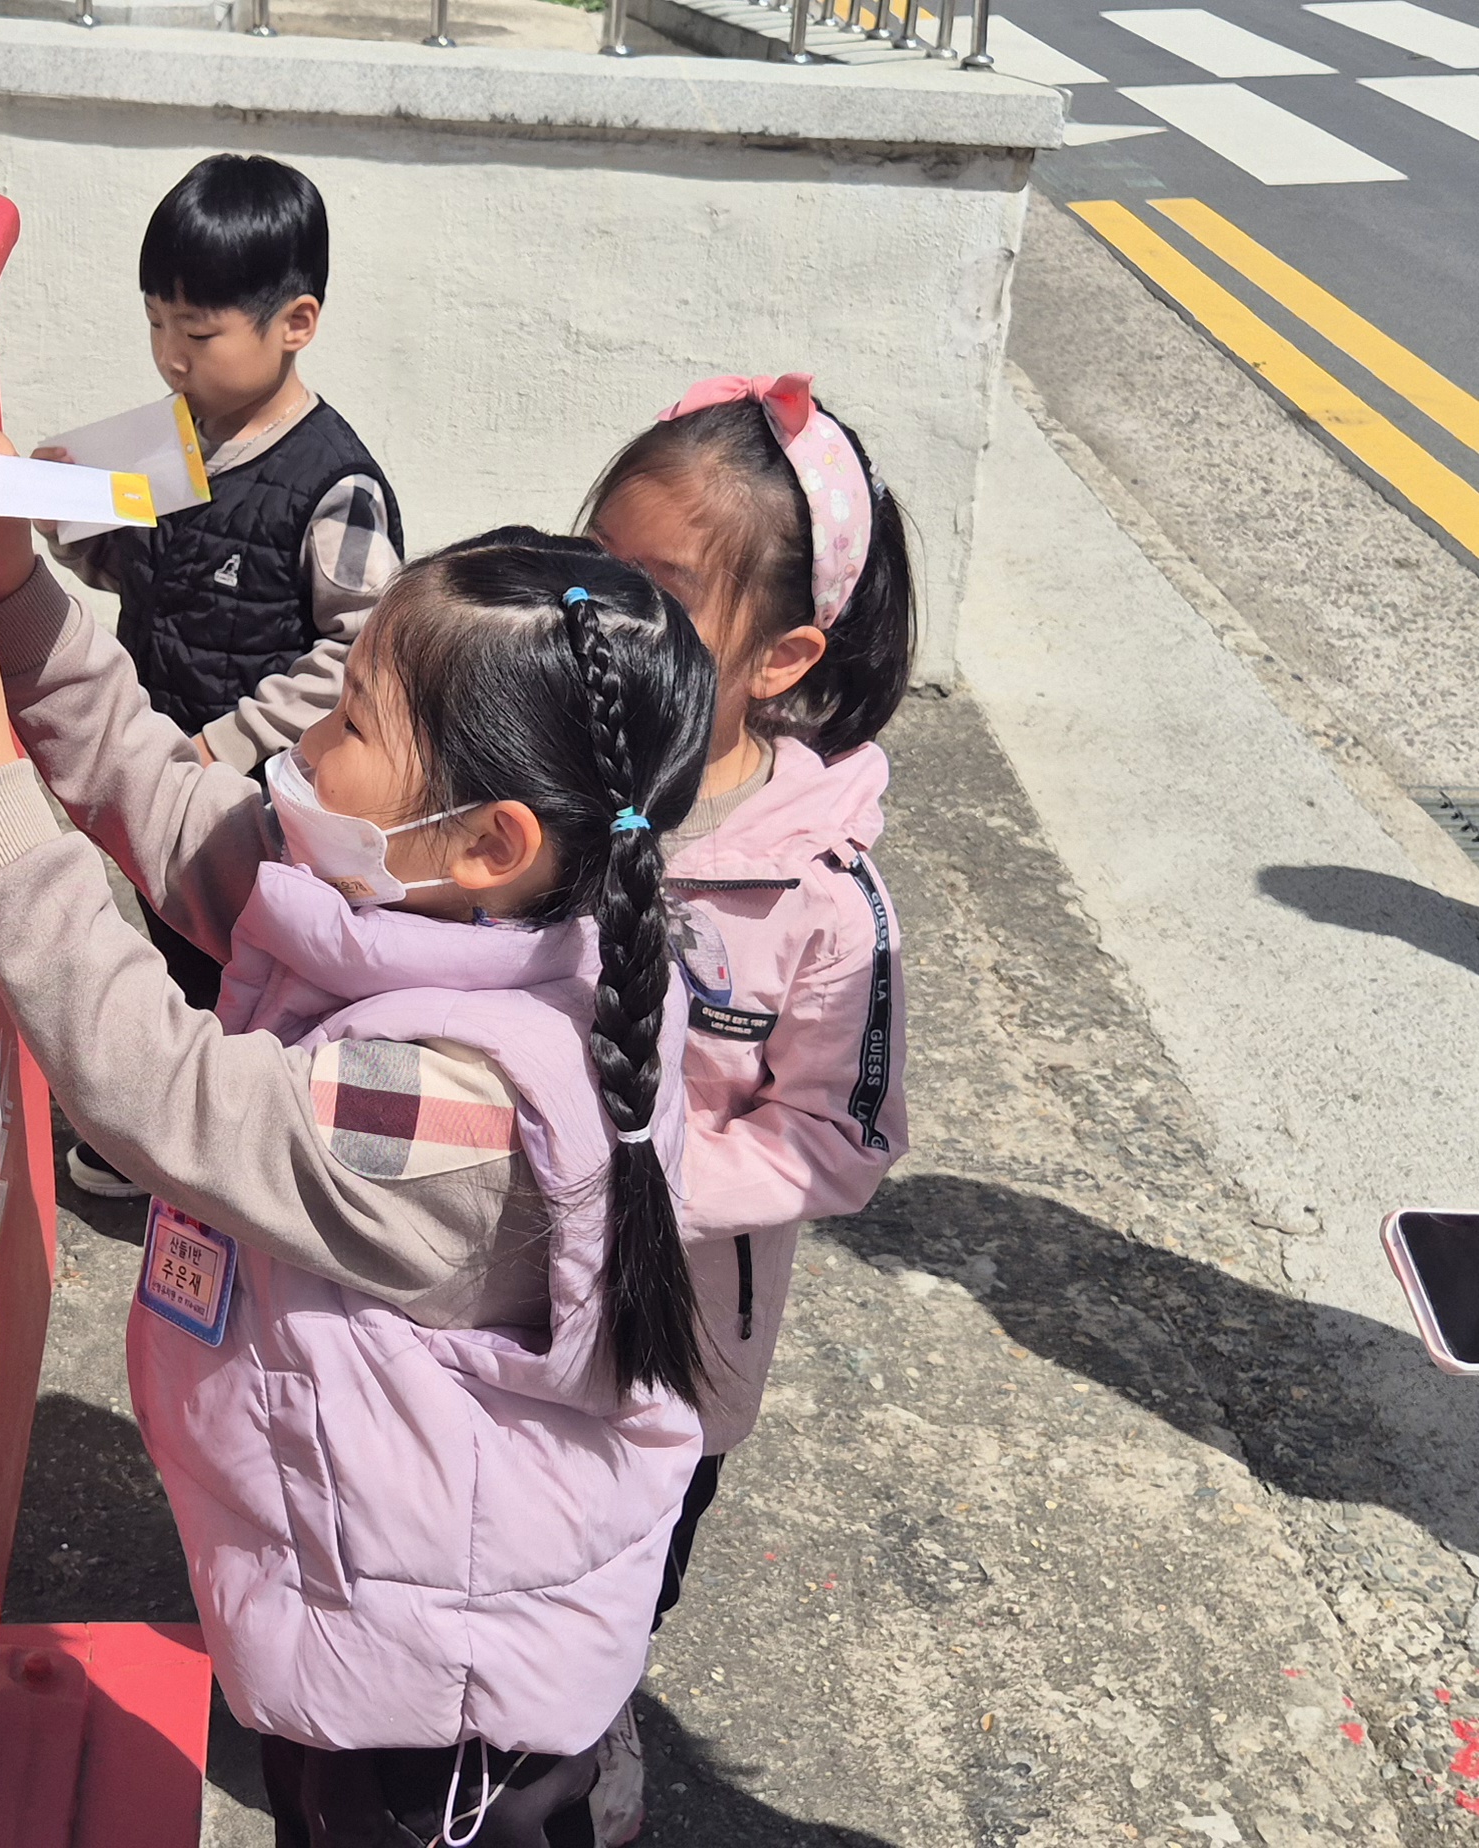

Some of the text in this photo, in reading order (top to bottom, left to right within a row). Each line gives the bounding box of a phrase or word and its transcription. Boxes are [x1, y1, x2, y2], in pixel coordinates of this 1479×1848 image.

[871, 891, 888, 951] GUESS
[876, 979, 887, 1001] LA
[866, 1029, 883, 1087] GUESS
[162, 1258, 202, 1297] 주은재
